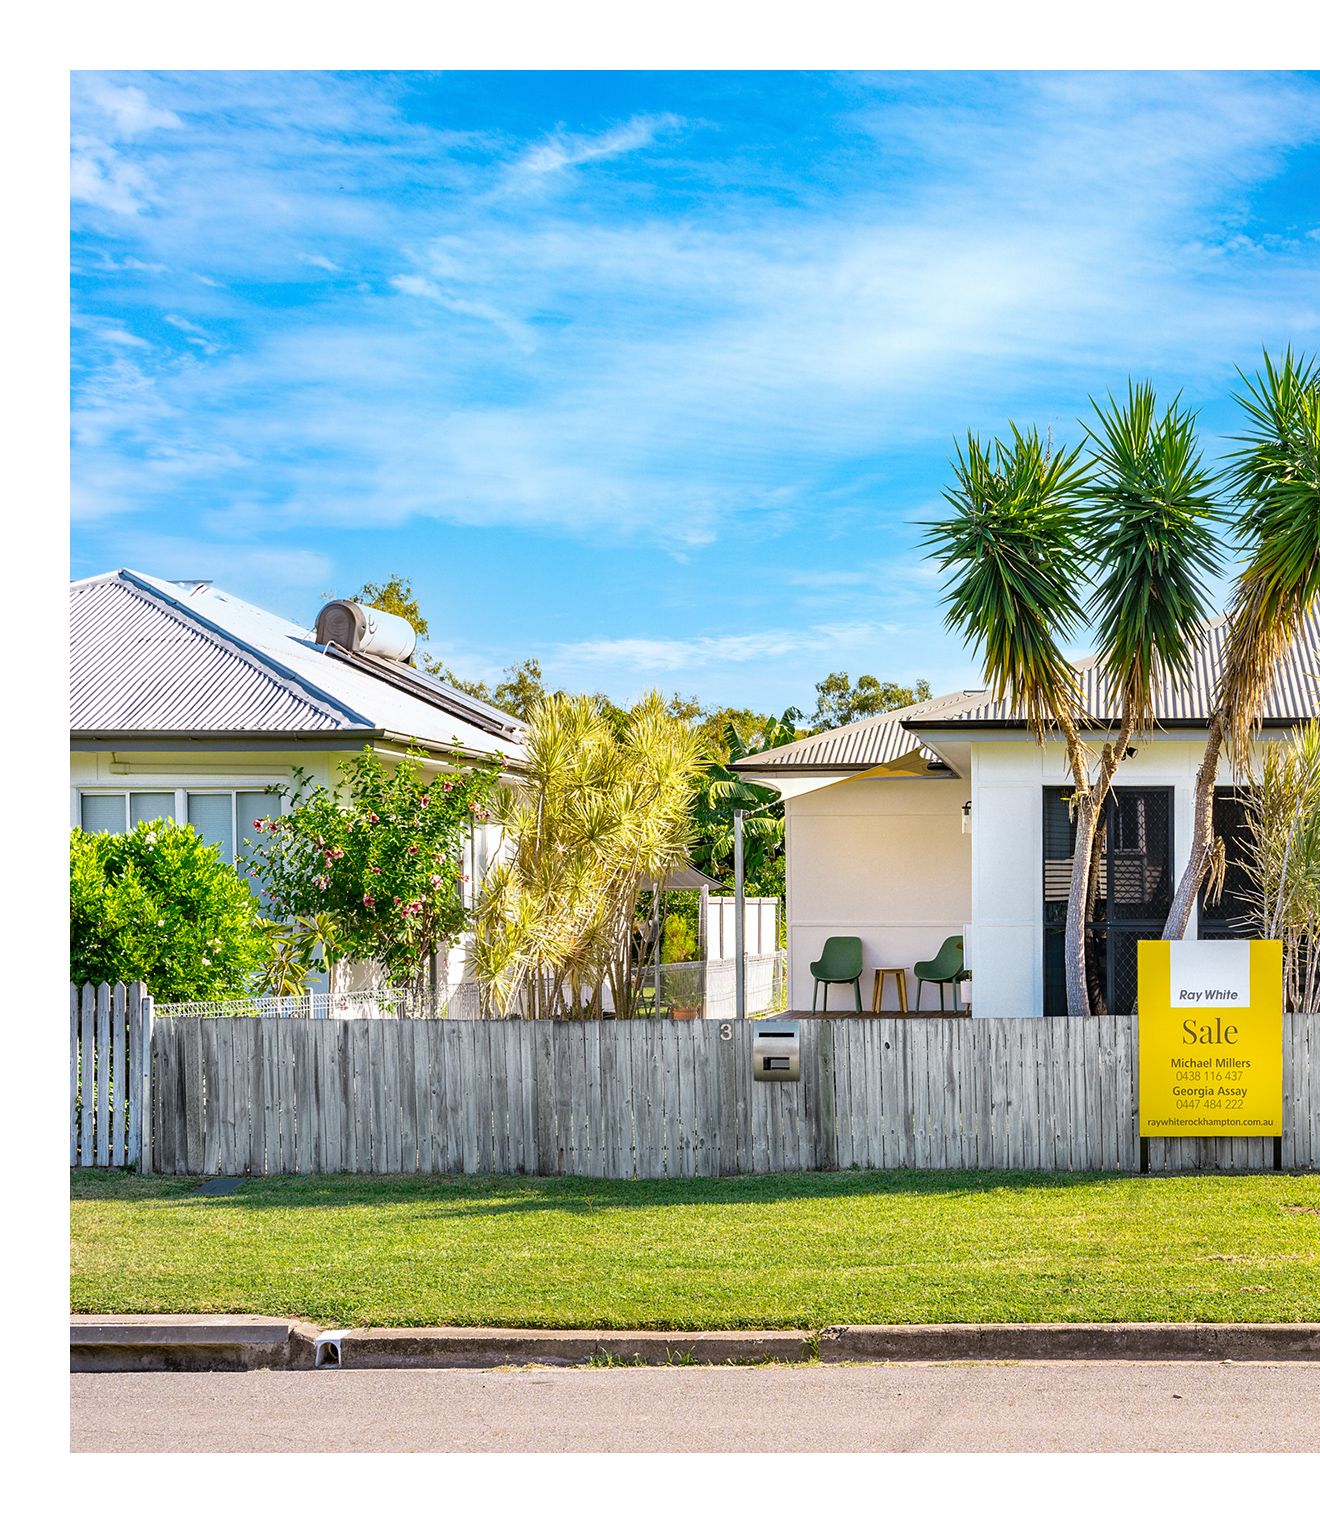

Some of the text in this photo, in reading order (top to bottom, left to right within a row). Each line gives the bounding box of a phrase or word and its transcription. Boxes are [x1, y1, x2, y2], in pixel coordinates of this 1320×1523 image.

[1179, 989, 1239, 1002] Ray White
[720, 1023, 732, 1041] 3
[1182, 1017, 1239, 1045] Sale
[1170, 1058, 1251, 1068] Michael Millers
[1176, 1071, 1243, 1081] 0438 116 437
[1172, 1086, 1248, 1098] Georgia Assay
[1176, 1099, 1244, 1110] 0447 484 222
[1147, 1117, 1274, 1127] raywhiterockhampton.com.au
